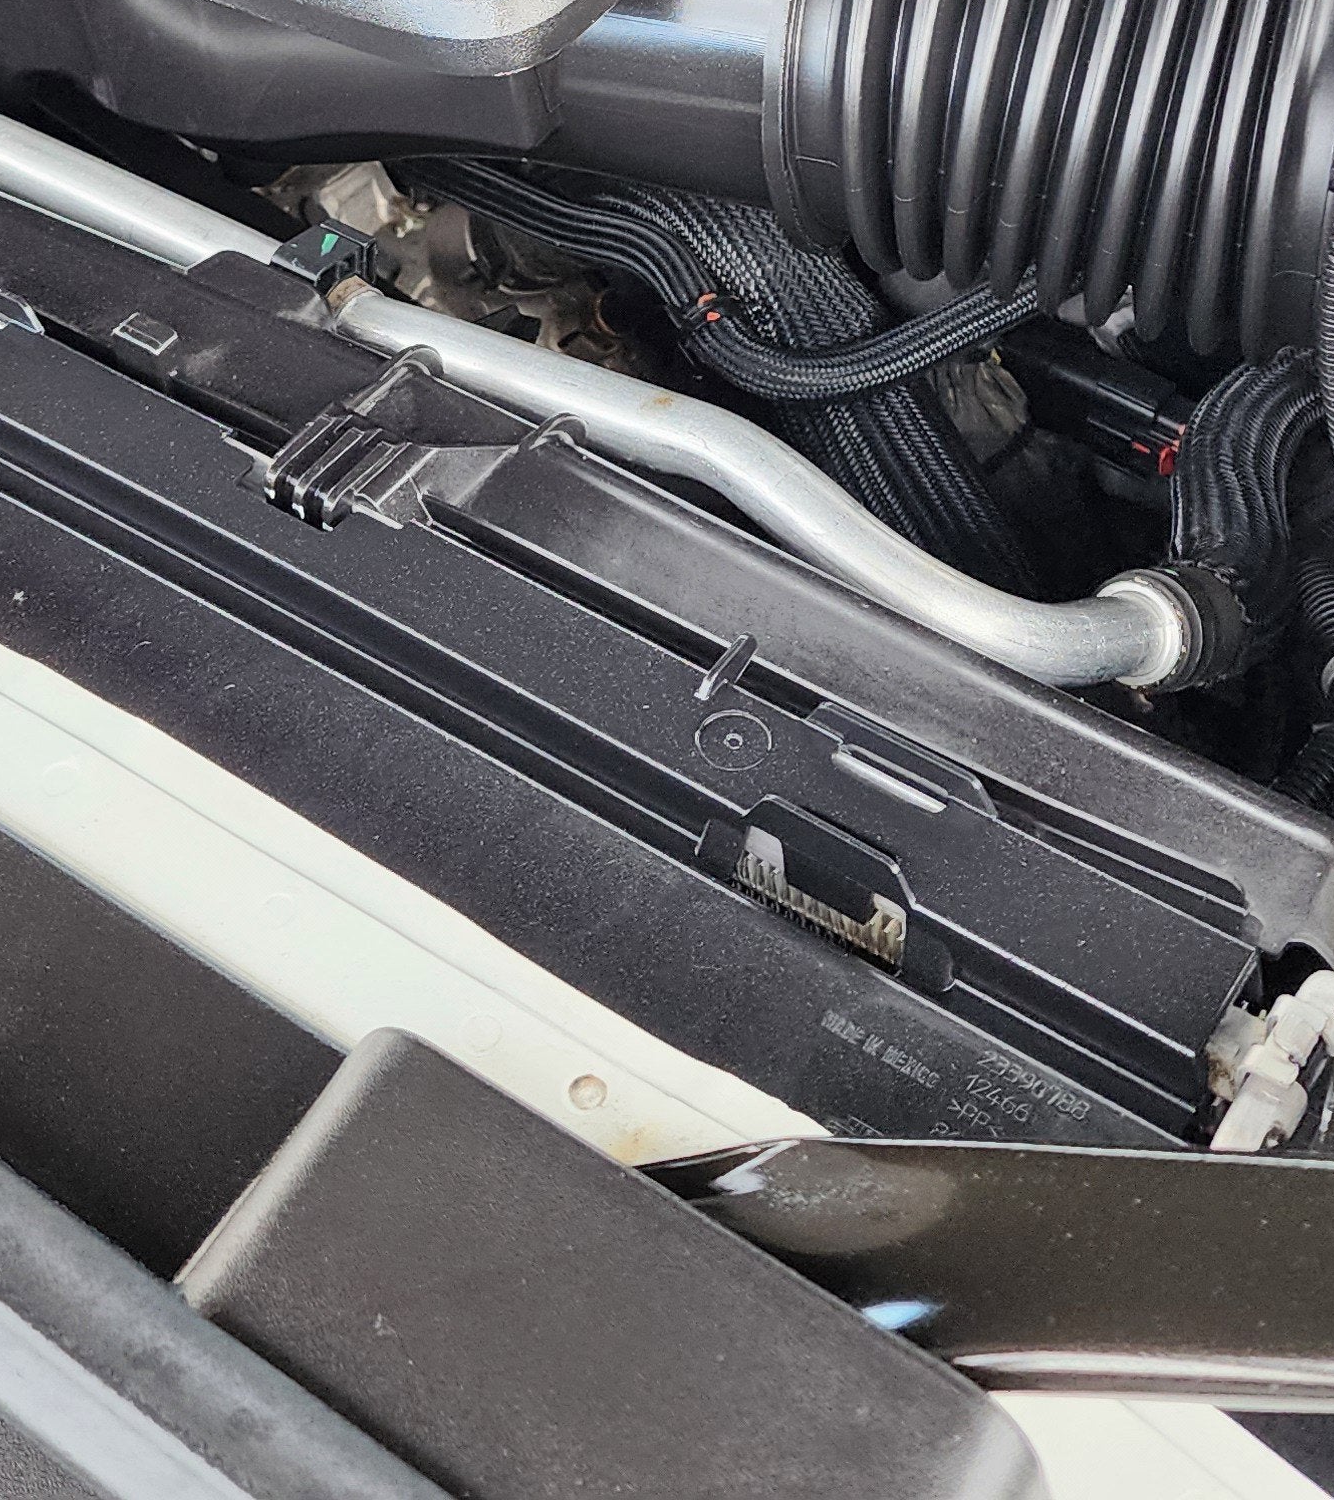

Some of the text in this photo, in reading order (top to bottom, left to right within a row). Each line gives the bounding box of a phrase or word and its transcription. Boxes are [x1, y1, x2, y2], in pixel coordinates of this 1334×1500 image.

[820, 1009, 865, 1045] MADE
[881, 1044, 941, 1089] MEXICO
[966, 1073, 1030, 1122] 12466
